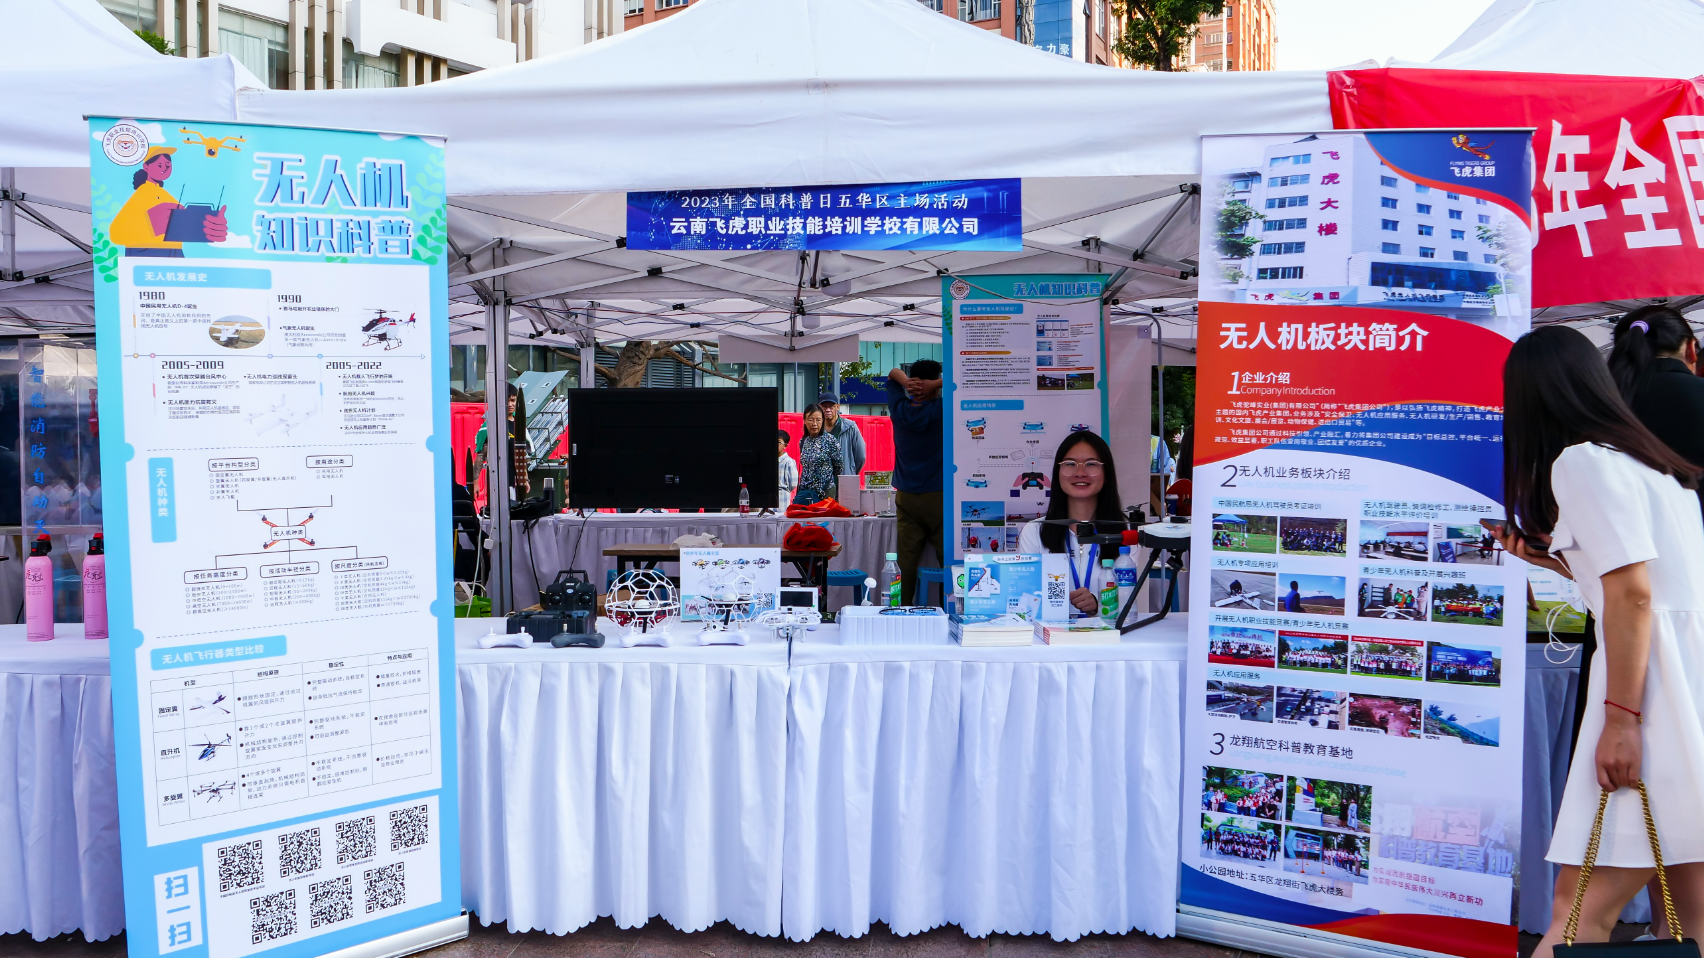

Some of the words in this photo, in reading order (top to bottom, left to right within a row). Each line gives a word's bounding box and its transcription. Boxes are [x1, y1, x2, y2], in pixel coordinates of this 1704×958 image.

[1450, 166, 1496, 178] 飞虎集团
[254, 154, 411, 210] 无人机
[1317, 150, 1341, 237] 飞虎大楼
[681, 193, 969, 210] 2023年全国科普日五华区主场活动
[669, 215, 980, 236] 云南飞虎职业技能培训学校有限公司
[256, 214, 412, 257] 知识科普
[144, 271, 208, 282] 无人机发展史
[1013, 282, 1102, 296] 无人机知识科普
[139, 291, 166, 301] 1980
[278, 295, 302, 304] 1990
[1219, 322, 1430, 351] 无人机板块简介
[162, 360, 225, 371] 2005-2009
[326, 361, 383, 371] 2005-2022
[1226, 370, 1241, 396] 1
[1240, 372, 1291, 385] 企业介绍
[29, 365, 51, 534] 智能消防自动灭
[314, 458, 346, 466] 按用途分类
[1220, 464, 1238, 488] 2
[1239, 465, 1351, 481] 无人机业务板块介绍
[156, 467, 169, 518] 无人机种类
[1219, 500, 1322, 511] 中国民航局无人机驾驶员考证培训
[272, 529, 306, 538] 无人机种类
[268, 565, 312, 575] 按活动半径分类
[1217, 559, 1279, 569] 无人机专项应用培训
[193, 571, 240, 580] 按任务高度分类
[1363, 566, 1467, 579] 青少年无人机科普及开展兴趣班
[1214, 614, 1349, 631] 开展无人机职业技能竞赛/青少年无人机竞赛
[162, 644, 265, 665] 无人机飞行器类型比较
[1213, 670, 1261, 681] 无人机应用服务
[183, 679, 196, 687] 机型
[158, 705, 178, 714] 固定翼
[160, 747, 181, 757] 直升机
[1209, 732, 1226, 756] 3
[1229, 735, 1354, 760] 龙翔航空科普教育基地
[163, 793, 184, 803] 多旋翼
[1199, 863, 1344, 897] 小公园地址：五华区龙翔街飞虎大楼旁
[165, 873, 192, 947] 扫一扫
